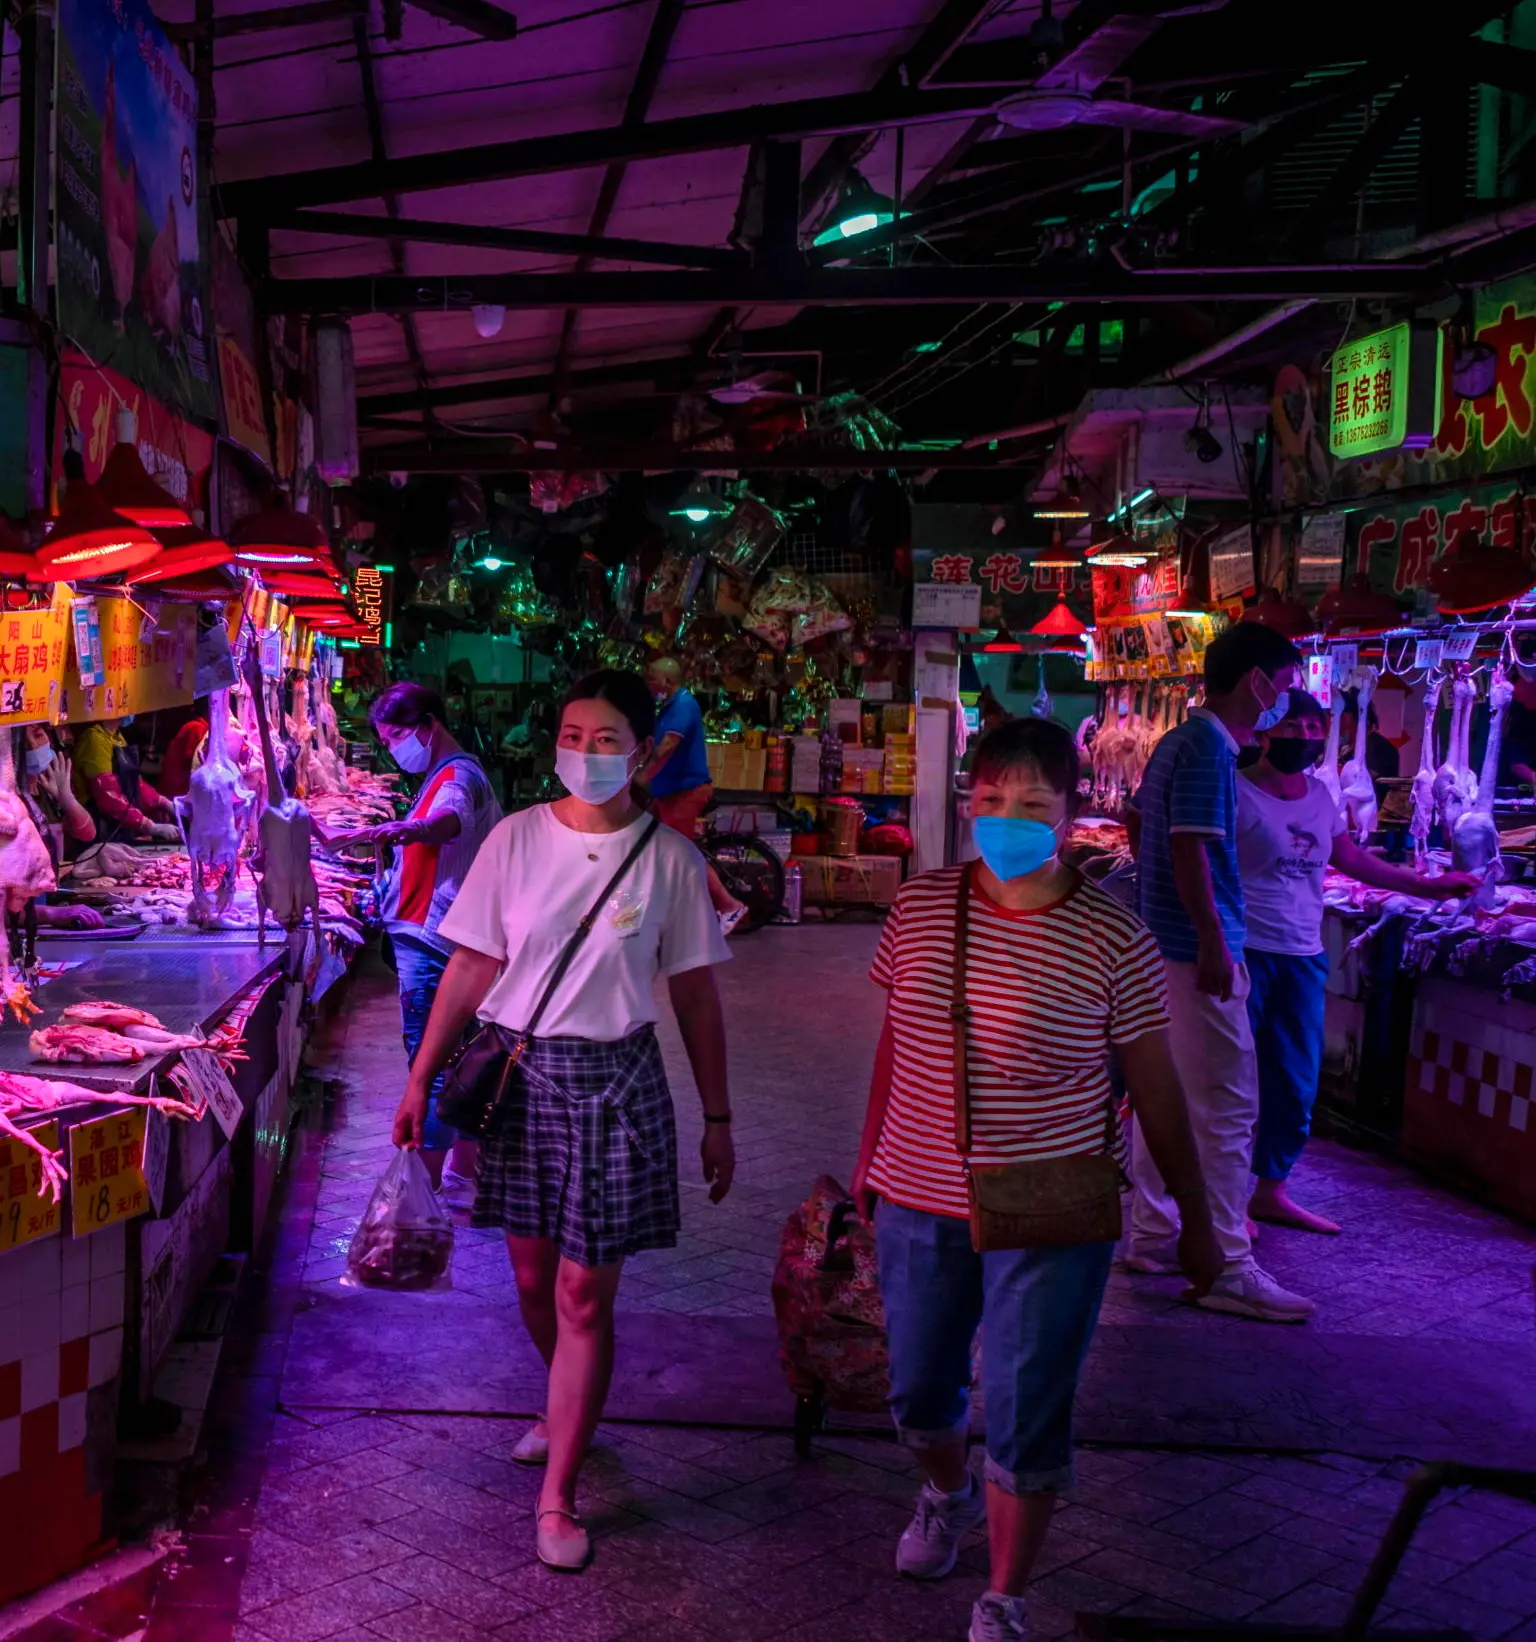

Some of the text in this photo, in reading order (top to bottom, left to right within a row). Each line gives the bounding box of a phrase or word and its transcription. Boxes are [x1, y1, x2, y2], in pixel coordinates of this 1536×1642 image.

[1337, 342, 1392, 375] 正宗清远
[1333, 367, 1392, 425] 黑棕鹅
[8, 619, 43, 640] 阳山
[78, 1141, 142, 1187] 果园鸡
